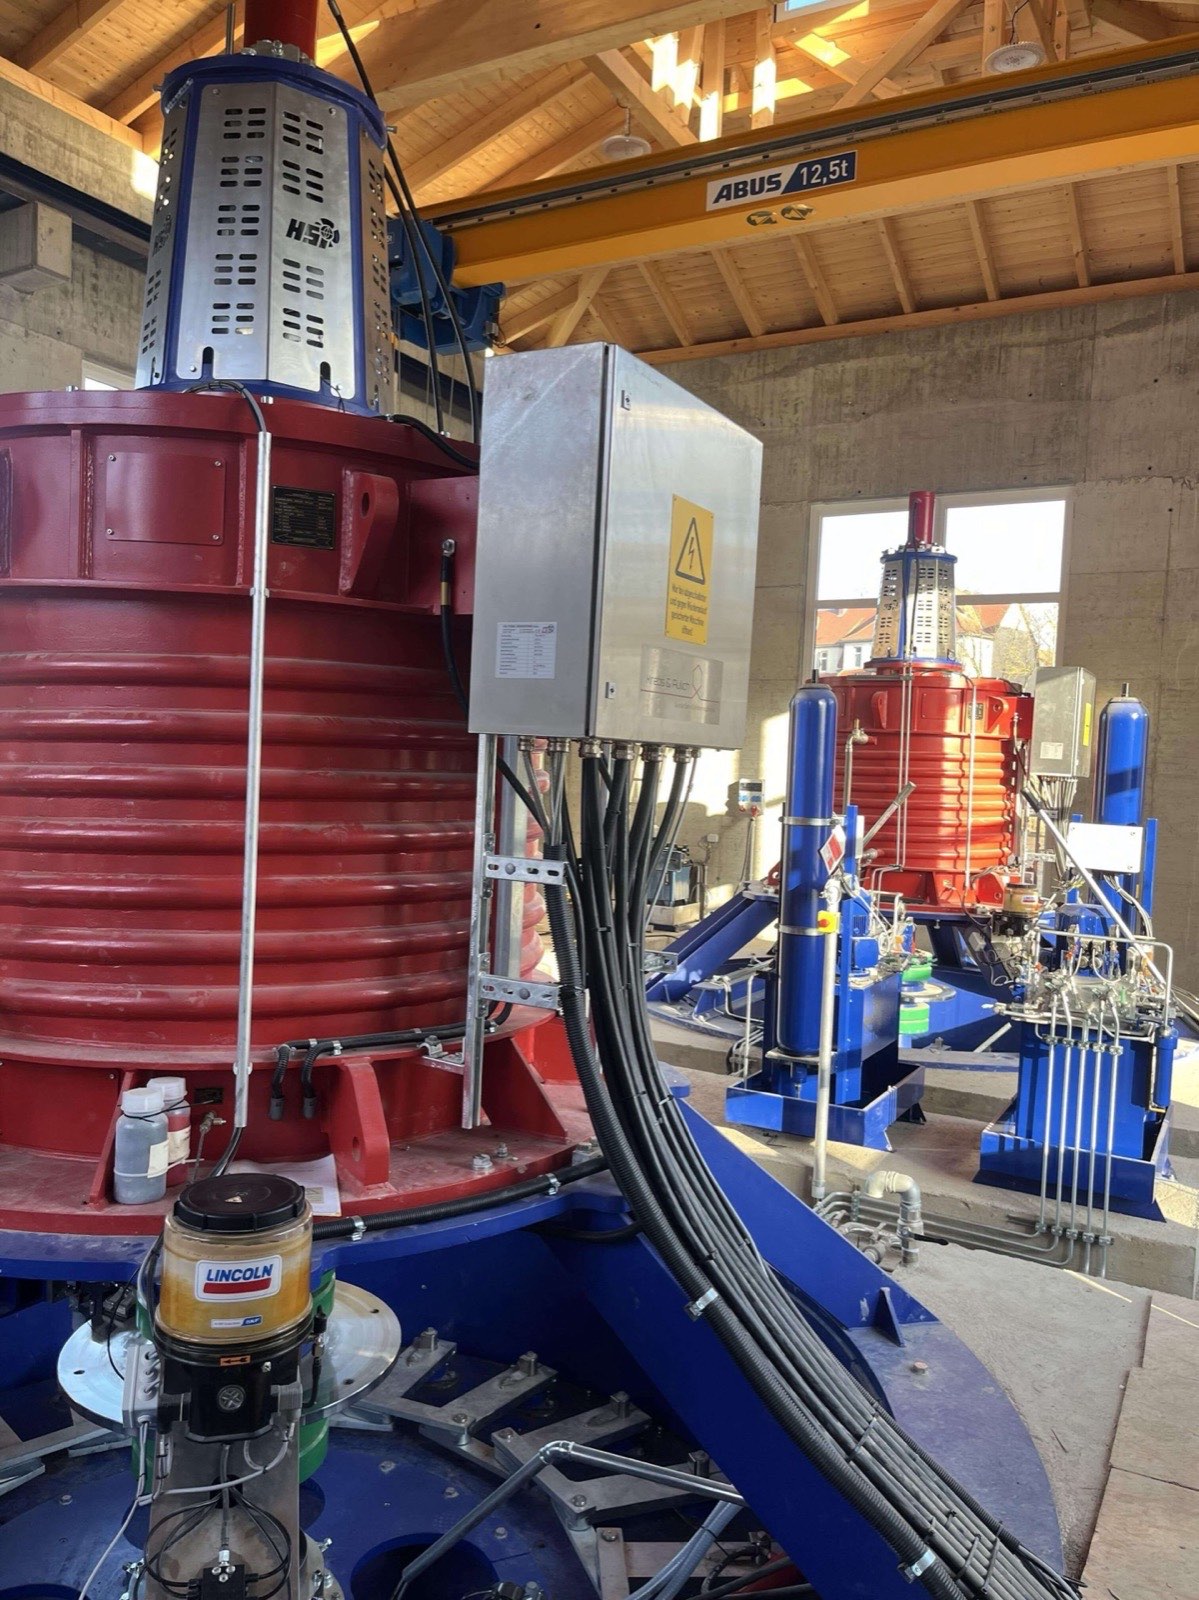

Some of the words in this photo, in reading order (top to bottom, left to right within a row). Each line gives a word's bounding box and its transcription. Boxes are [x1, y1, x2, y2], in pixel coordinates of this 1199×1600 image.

[712, 172, 783, 204] ABUS
[800, 159, 848, 187] 12,5t
[206, 1264, 274, 1282] LINCOLN
